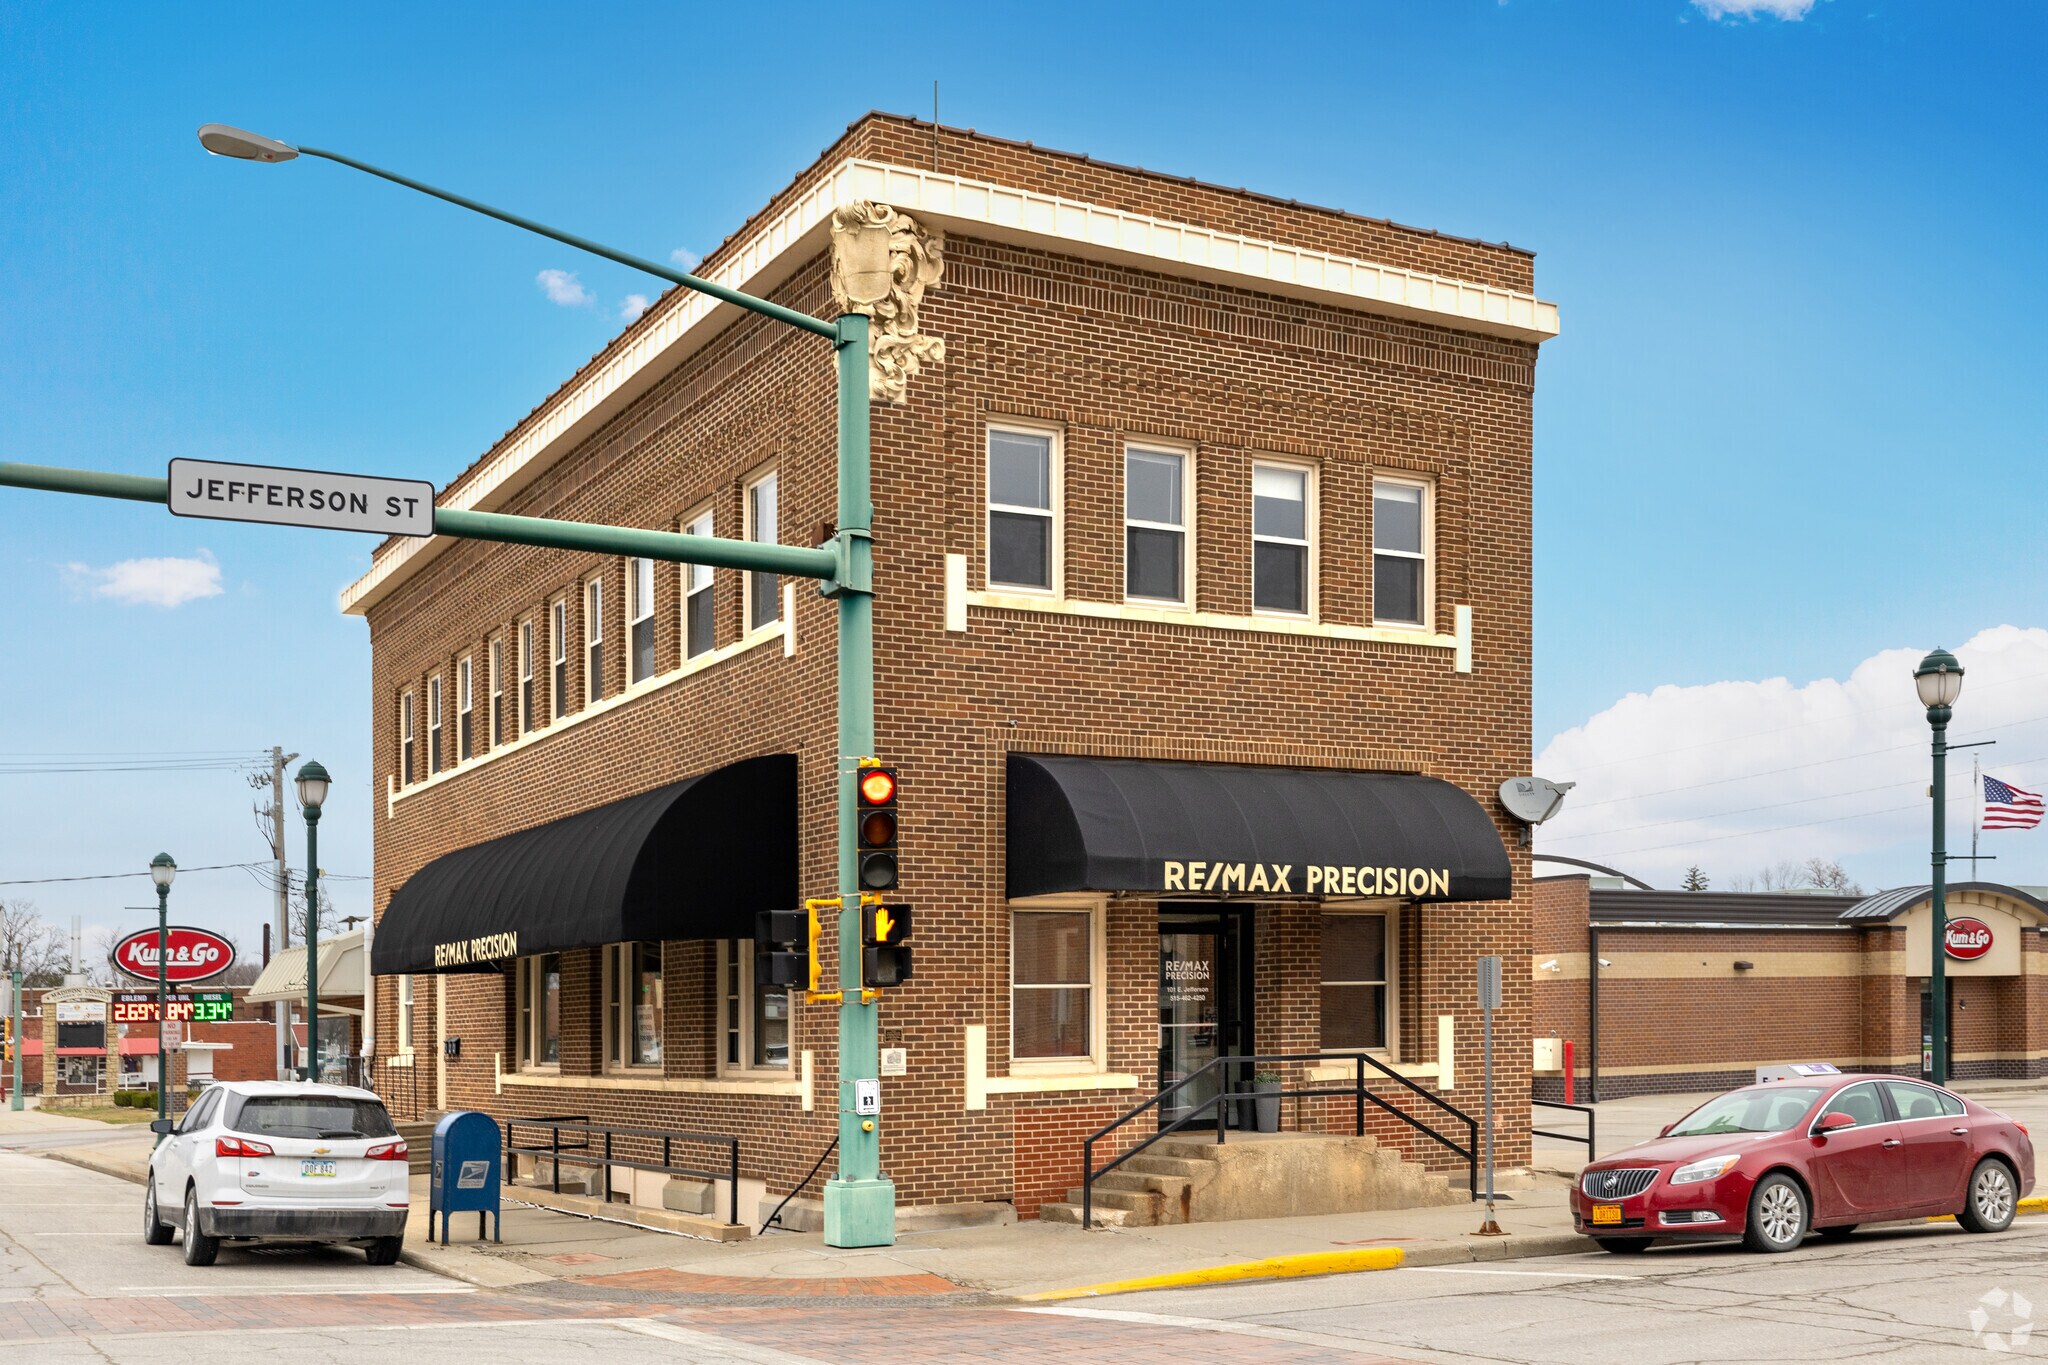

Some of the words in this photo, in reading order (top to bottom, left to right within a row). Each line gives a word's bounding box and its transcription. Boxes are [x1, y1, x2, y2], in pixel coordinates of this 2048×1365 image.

[186, 478, 367, 514] JEFFERSON
[385, 496, 418, 518] ST
[1164, 861, 1292, 892] RE/MAX
[1307, 865, 1449, 896] PRECISION
[192, 942, 219, 966] Go
[435, 940, 469, 967] RE/MAX
[471, 931, 517, 962] PRECISION
[1165, 960, 1209, 971] RE/MAX
[1165, 971, 1210, 980] PRECISION
[121, 994, 148, 1002] EBLEND
[156, 994, 177, 1002] SPER
